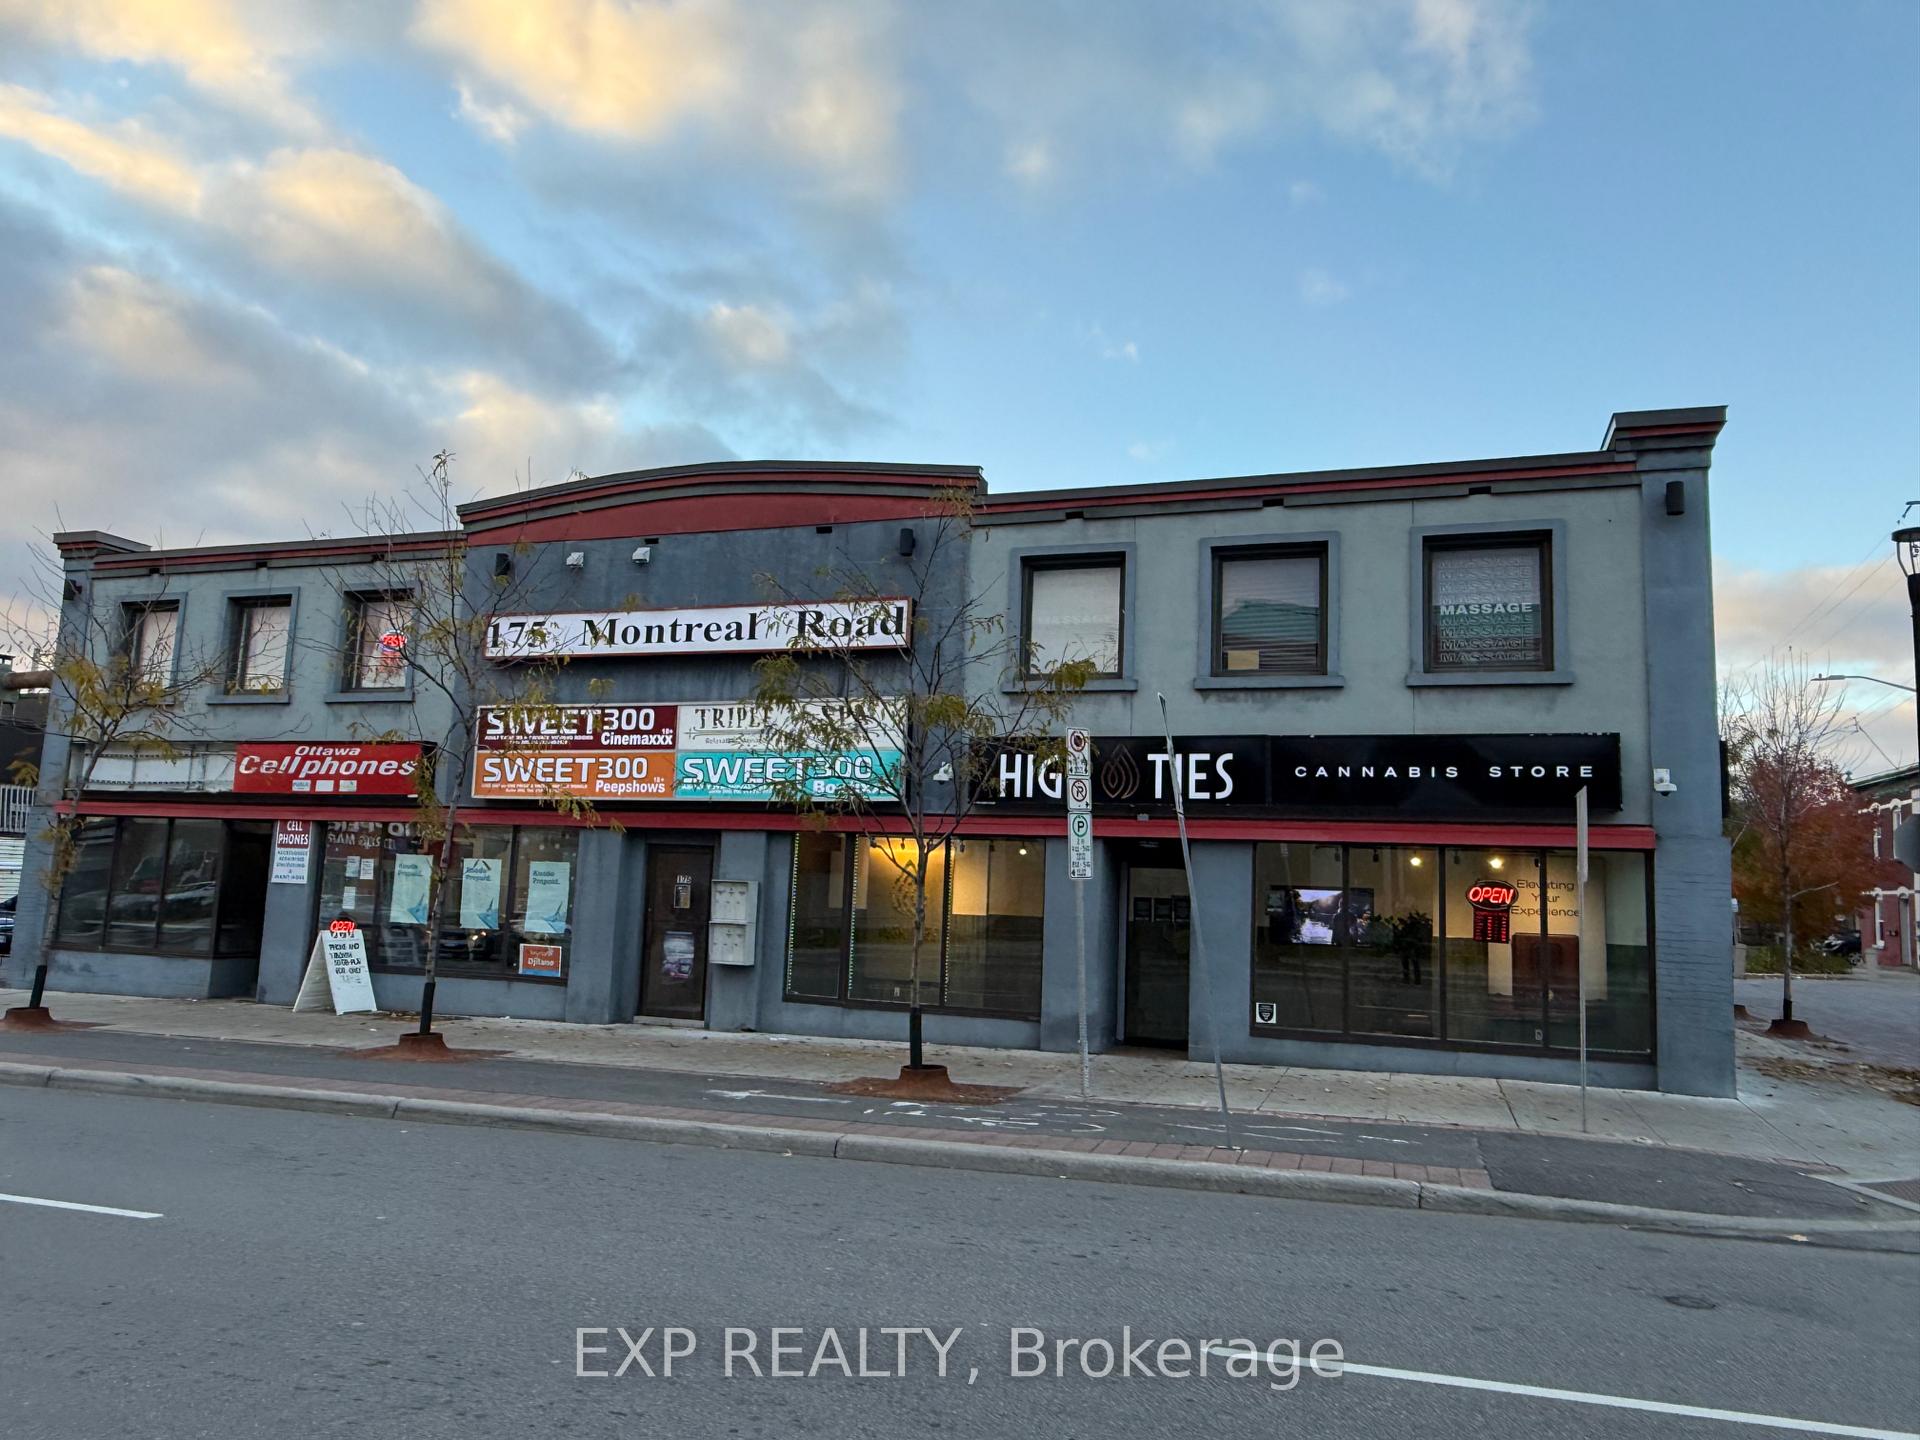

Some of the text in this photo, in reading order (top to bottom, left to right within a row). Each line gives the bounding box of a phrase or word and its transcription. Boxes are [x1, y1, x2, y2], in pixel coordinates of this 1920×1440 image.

[1440, 602, 1533, 615] MASSAGE
[580, 612, 758, 647] Montreal
[798, 606, 905, 638] Road
[486, 708, 655, 735] SWEET 300
[601, 731, 673, 746] Cinemaxxx
[294, 746, 361, 756] Ottawa
[238, 755, 418, 778] Cellphones
[483, 757, 648, 783] SWEET 300
[683, 755, 872, 785] SWEET 300
[1294, 766, 1593, 778] CANNABIS STORE
[1000, 753, 1233, 799] HIG TIES
[595, 779, 666, 796] Peepshows
[286, 820, 303, 831] CELL
[278, 833, 309, 845] PHONES
[1516, 879, 1575, 891] Elevting
[1469, 886, 1514, 905] OPEN
[1531, 892, 1560, 903] Yur
[1511, 905, 1581, 918] Expeience
[330, 920, 355, 933] OPEN
